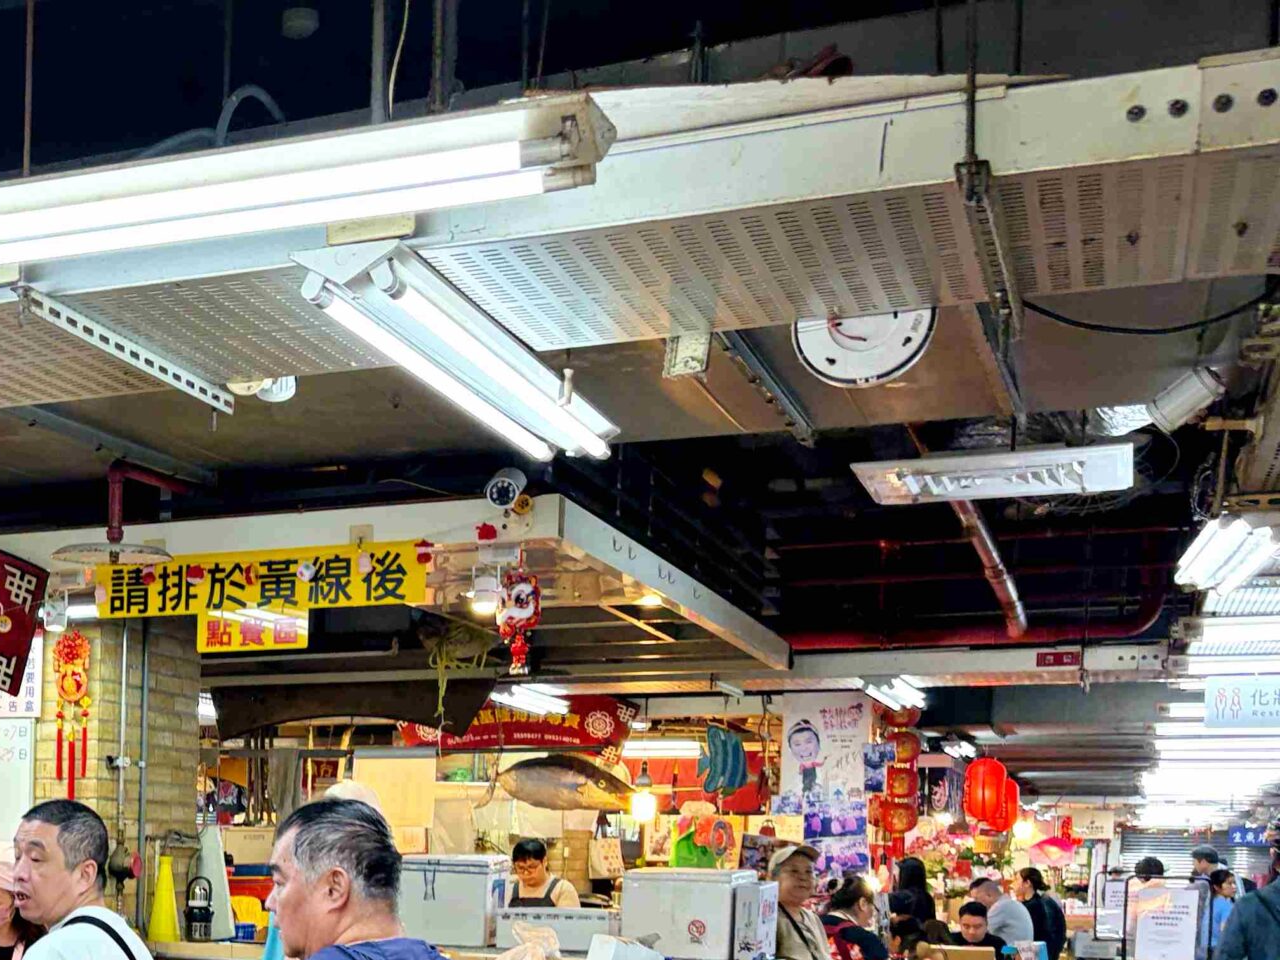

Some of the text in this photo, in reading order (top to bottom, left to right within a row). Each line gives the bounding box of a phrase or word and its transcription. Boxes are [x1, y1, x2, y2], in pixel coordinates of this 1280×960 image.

[109, 550, 409, 616] 請排於黃線後
[205, 617, 300, 648] 點餐區
